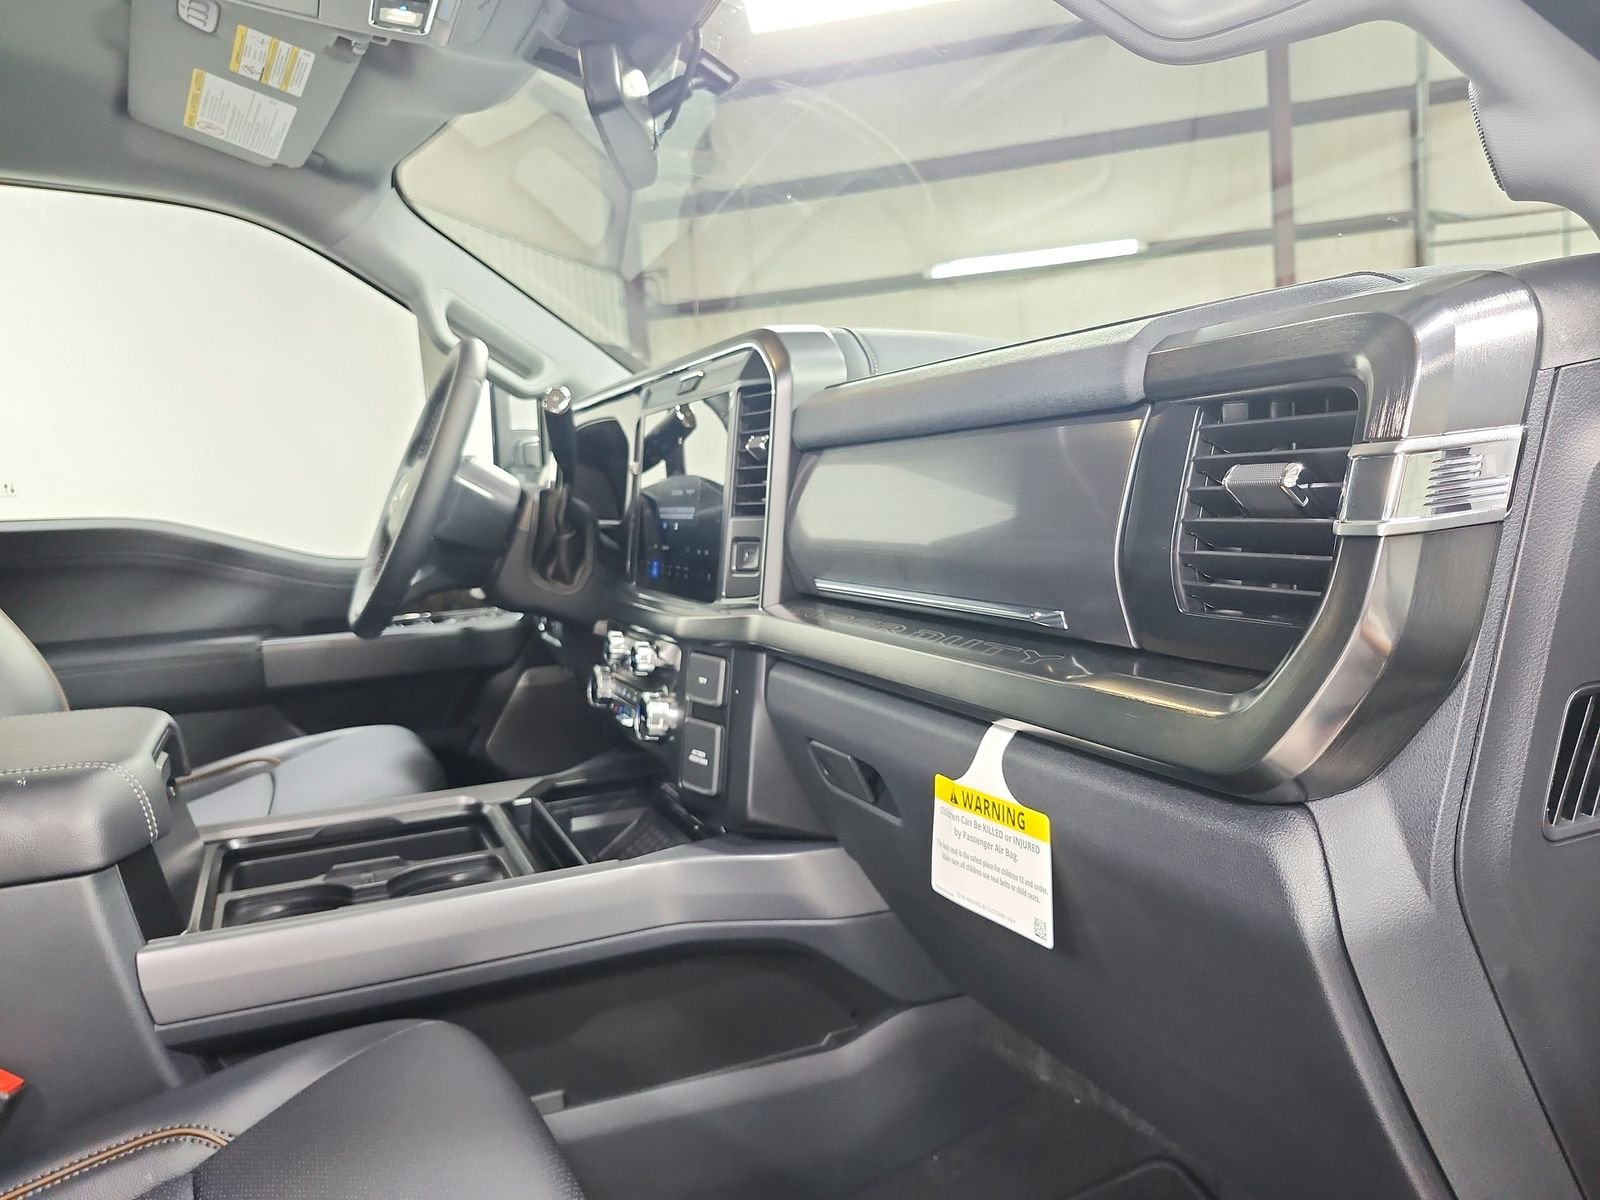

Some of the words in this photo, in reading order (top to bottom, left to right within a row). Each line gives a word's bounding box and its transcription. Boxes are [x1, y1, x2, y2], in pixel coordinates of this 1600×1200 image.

[910, 629, 1065, 664] DUTY
[962, 790, 1025, 830] WARNING
[940, 806, 960, 822] Children
[960, 815, 972, 827] Can
[973, 820, 982, 830] Be
[982, 823, 1004, 839] KILLED
[1004, 834, 1012, 843] or
[1013, 835, 1040, 855] INJURED
[954, 827, 962, 840] by
[963, 831, 994, 851] Passenger
[994, 843, 1004, 855] Air
